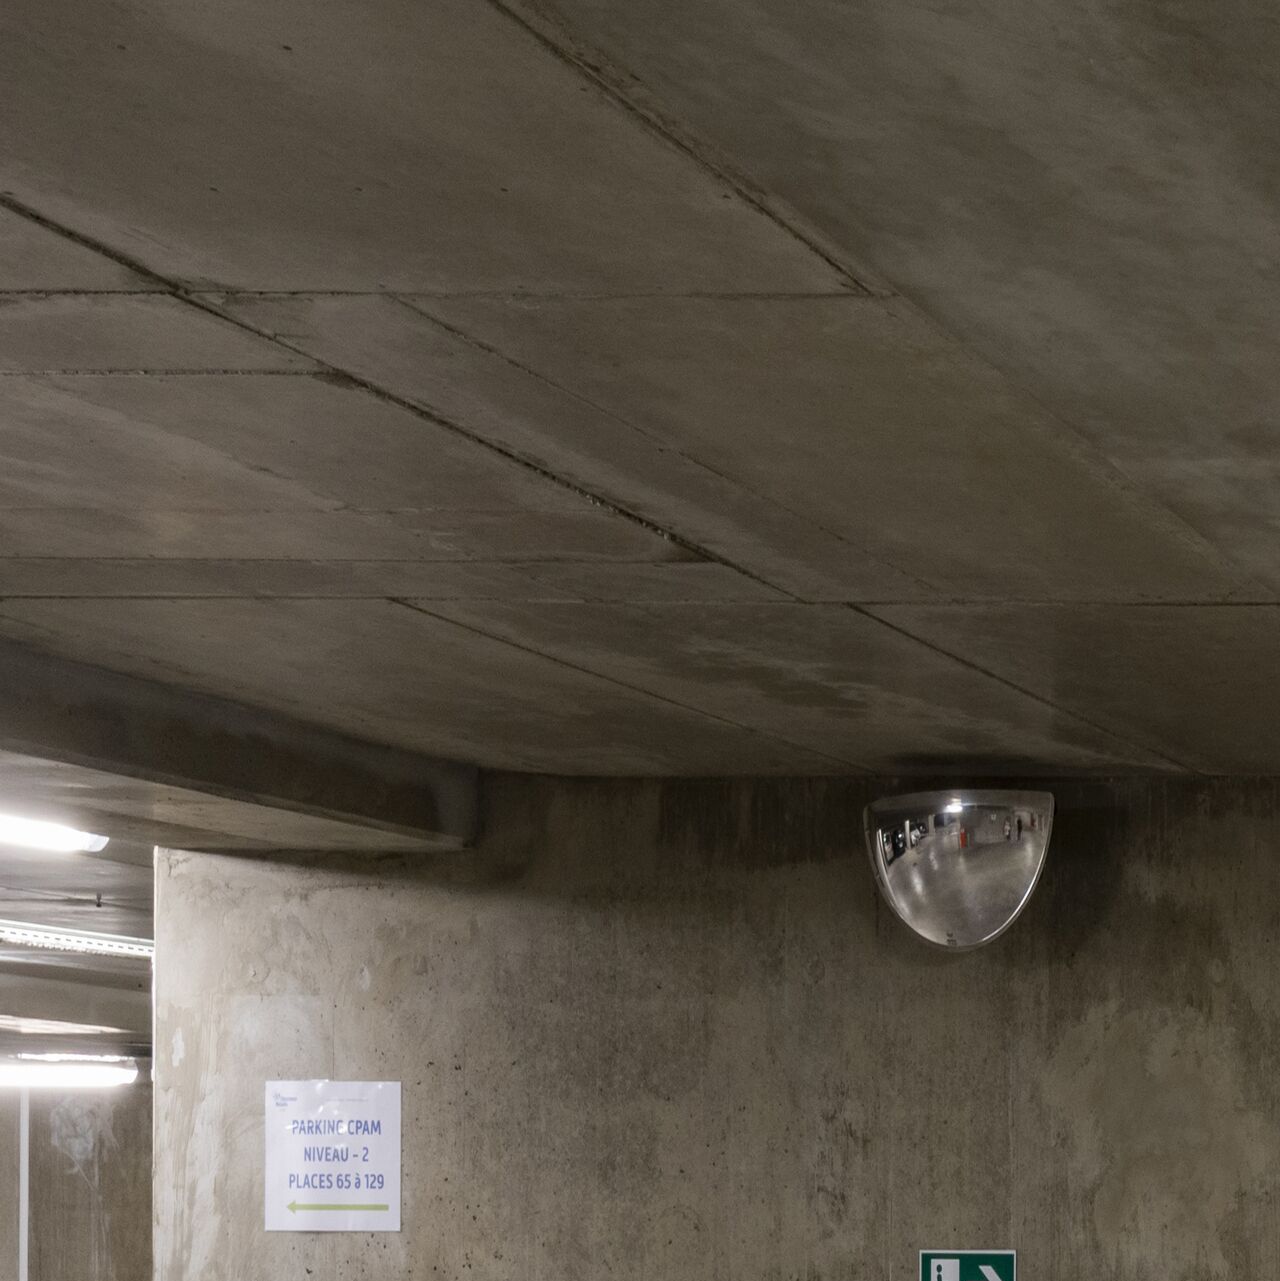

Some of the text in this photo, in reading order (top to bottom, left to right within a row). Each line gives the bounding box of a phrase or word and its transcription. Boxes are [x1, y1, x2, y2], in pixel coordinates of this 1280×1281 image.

[292, 1119, 382, 1135] PARKING CPAM
[303, 1147, 349, 1162] NIVEAU
[362, 1147, 369, 1162] 2
[289, 1173, 385, 1189] PLACES 65 à 129
